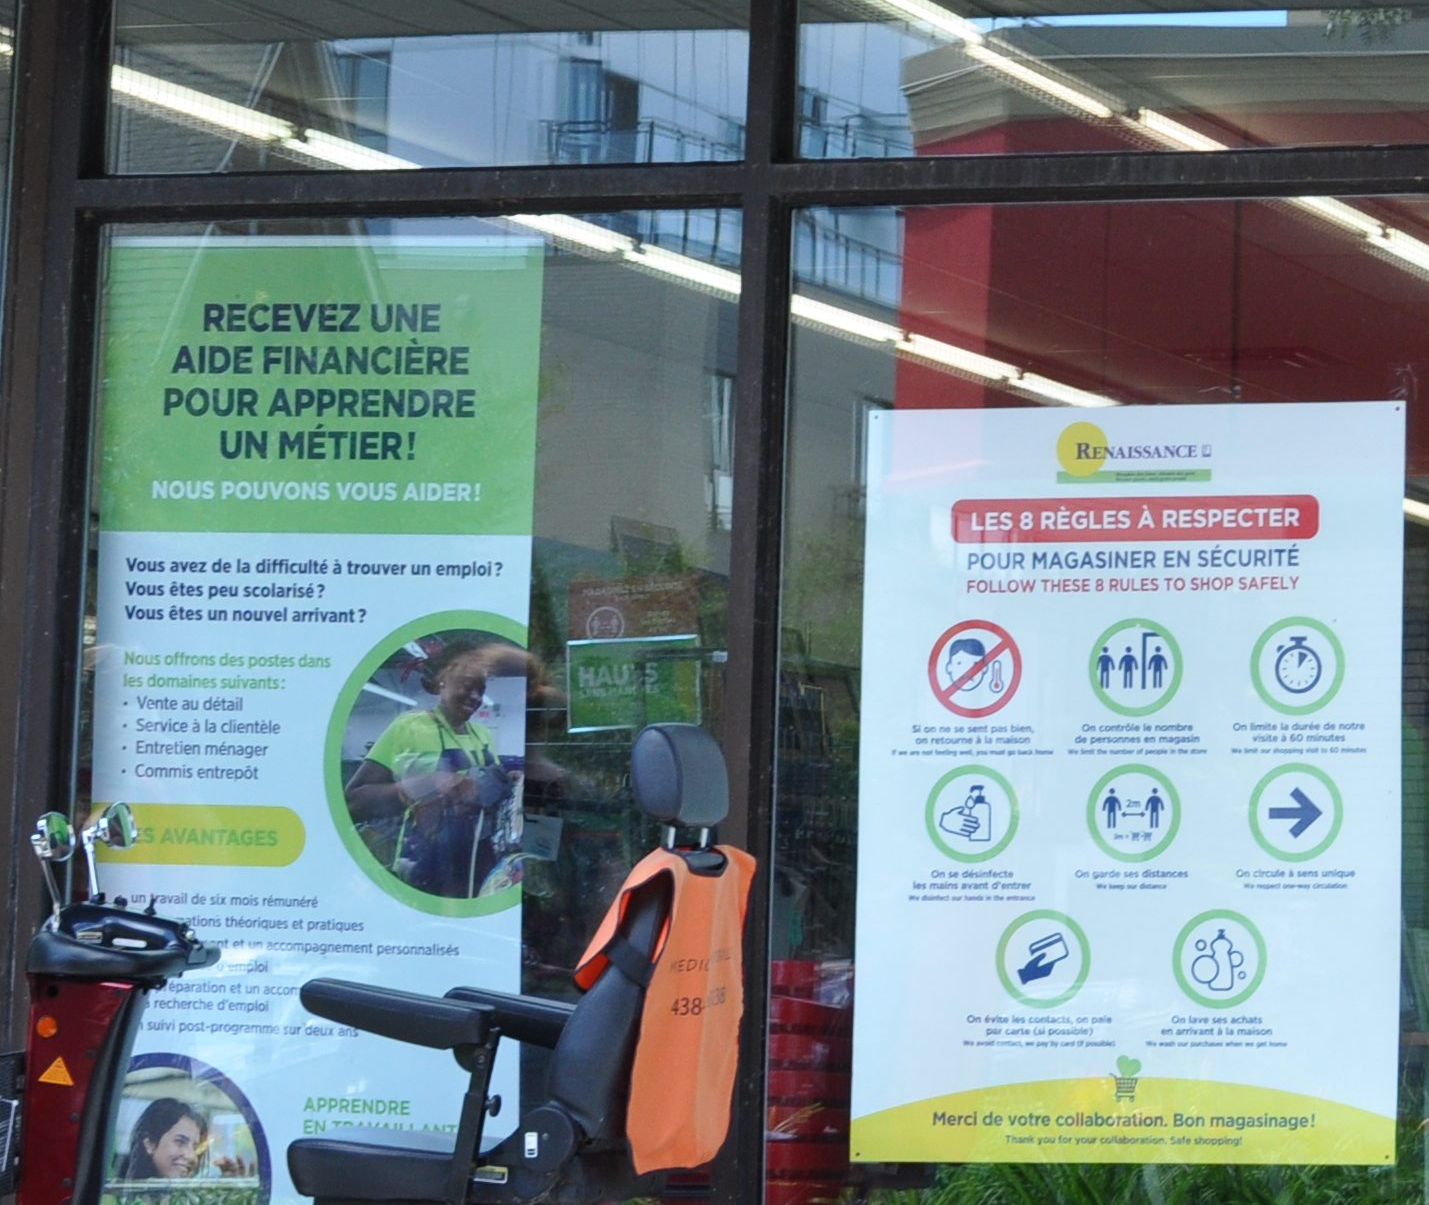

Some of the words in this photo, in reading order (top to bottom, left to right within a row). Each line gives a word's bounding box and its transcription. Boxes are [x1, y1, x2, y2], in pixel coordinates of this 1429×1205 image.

[203, 303, 361, 333] RECEVEZ
[370, 303, 441, 333] UNE
[171, 345, 253, 374] AIDE
[263, 337, 470, 375] FINANCIÈRE
[163, 387, 258, 417] POUR
[267, 388, 476, 418] APPRENDRE
[219, 430, 268, 460] UN
[1075, 442, 1197, 460] RENAISSANCE
[152, 480, 215, 500] NOUS
[221, 481, 330, 500] POUVONS
[336, 482, 397, 501] VOUS
[971, 511, 1013, 531] LES
[1019, 511, 1033, 530] 8
[1040, 506, 1131, 530] RÈGLES
[1137, 505, 1155, 529] À
[1162, 508, 1300, 528] RESPECTER
[967, 552, 1025, 570] POUR
[1032, 550, 1156, 570] MAGASINER
[1165, 550, 1191, 568] EN
[1198, 544, 1300, 567] SÉCURITÉ
[126, 557, 165, 573] Vous
[170, 561, 207, 573] avez
[211, 558, 232, 573] de
[237, 559, 250, 573] la
[256, 559, 329, 575] difficulté
[333, 559, 342, 575] à
[347, 560, 406, 576] trouver
[411, 563, 430, 576] un
[125, 581, 164, 596] Vous
[169, 582, 204, 597] êtes
[208, 585, 238, 600] peu
[967, 580, 1036, 593] FOLLOW
[1041, 579, 1091, 593] THESE
[1095, 579, 1104, 592] 8
[1109, 578, 1159, 592] RULES
[1165, 578, 1185, 591] TO
[1191, 577, 1234, 591] SHOP
[1239, 576, 1300, 591] SAFELY
[125, 605, 164, 620] Vous
[169, 605, 203, 620] êtes
[207, 609, 228, 621] un
[232, 607, 287, 622] nouvel
[124, 651, 161, 666] Nous
[164, 651, 216, 667] offrons
[219, 652, 245, 667] des
[248, 654, 295, 669] postes
[298, 654, 330, 668] dans
[123, 673, 143, 687] les
[147, 673, 217, 689] domaines
[578, 662, 659, 687] HAUS
[137, 696, 178, 710] Vente
[181, 700, 199, 711] au
[203, 697, 244, 711] détail
[135, 718, 188, 733] Service
[192, 719, 200, 733] à
[205, 719, 217, 734] la
[221, 719, 281, 734] clientèle
[135, 740, 200, 755] Entretien
[204, 742, 268, 759] ménager
[135, 764, 193, 779] Commis
[197, 765, 259, 782] entrepôt
[160, 828, 279, 846] AVANTAGES
[131, 895, 146, 904] un
[191, 894, 206, 905] de
[210, 894, 226, 906] six
[230, 895, 259, 906] mois
[262, 895, 318, 908] rémunéré
[225, 916, 288, 930] théoriques
[292, 919, 303, 929] et
[307, 919, 364, 932] pratiques
[267, 941, 372, 955] accompagnement
[376, 944, 459, 956] personnalisés
[154, 999, 213, 1011] recherche
[217, 1000, 269, 1013] d'emploi
[147, 1020, 175, 1031] suivi
[179, 1022, 279, 1035] post-programme
[284, 1027, 300, 1035] sur
[305, 1025, 333, 1036] deux
[304, 1097, 410, 1115] APPRENDRE
[932, 1112, 978, 1126] Merci
[982, 1112, 1003, 1127] de
[1008, 1113, 1051, 1127] votre
[1056, 1112, 1168, 1128] collaboration.
[1173, 1113, 1205, 1127] Bon
